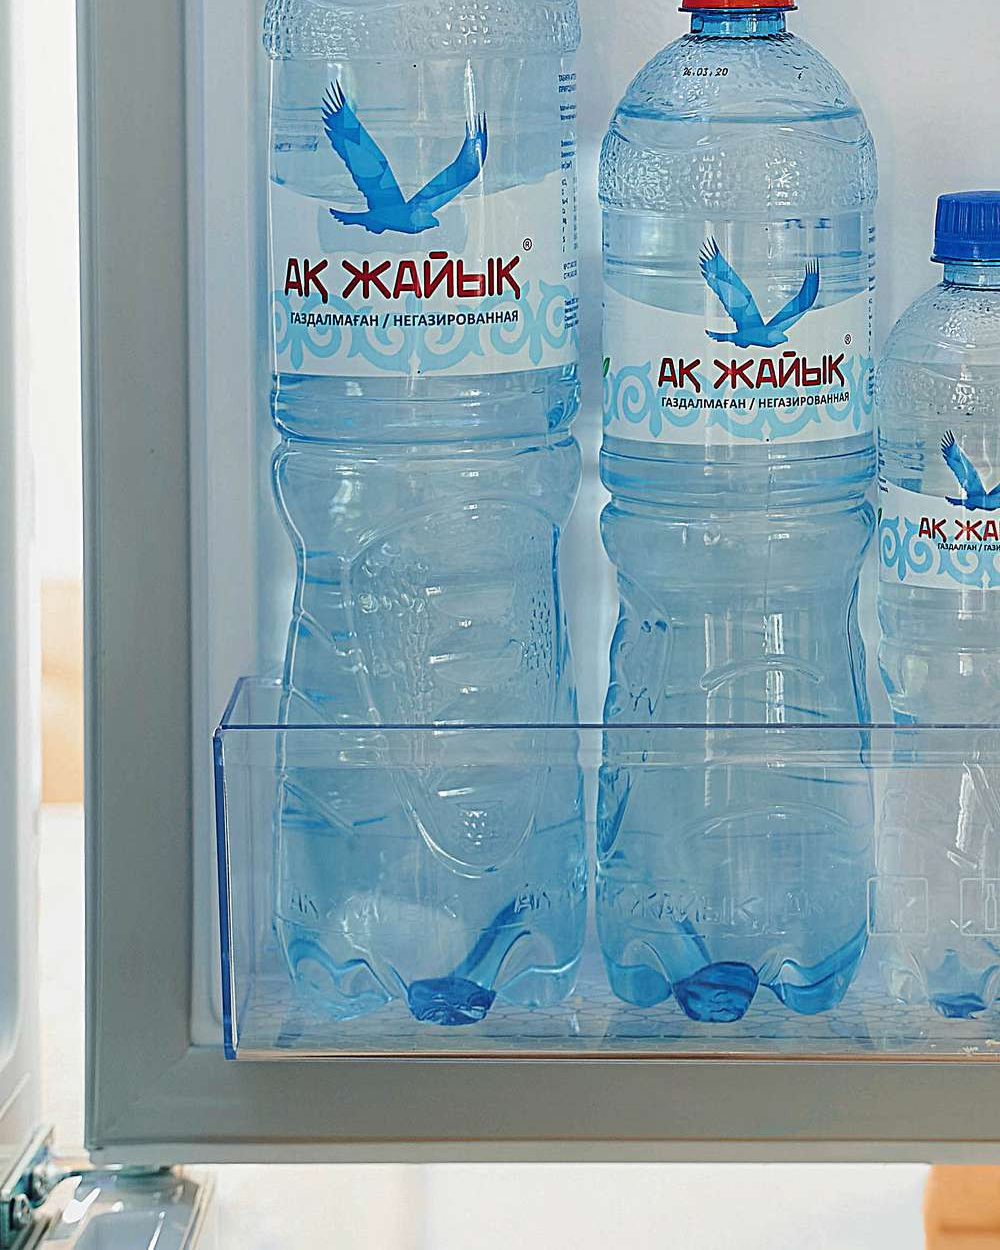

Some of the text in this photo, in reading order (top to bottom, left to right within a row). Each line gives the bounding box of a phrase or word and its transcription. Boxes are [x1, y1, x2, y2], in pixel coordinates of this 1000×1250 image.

[285, 258, 328, 303] АҚ
[342, 251, 521, 300] ЖАЙЫҚ
[290, 312, 379, 327] ГАЗДАЛМАҒАН
[393, 309, 519, 327] НЕГАЗИРОВАННАЯ
[658, 357, 701, 393] АҚ
[713, 350, 845, 389] ЖАЙЫҚ
[661, 396, 746, 410] ГАЗДАЛМАҒАН
[757, 391, 850, 409] НЕГАЗИРОВАННАЯ
[918, 517, 947, 543] АҚ
